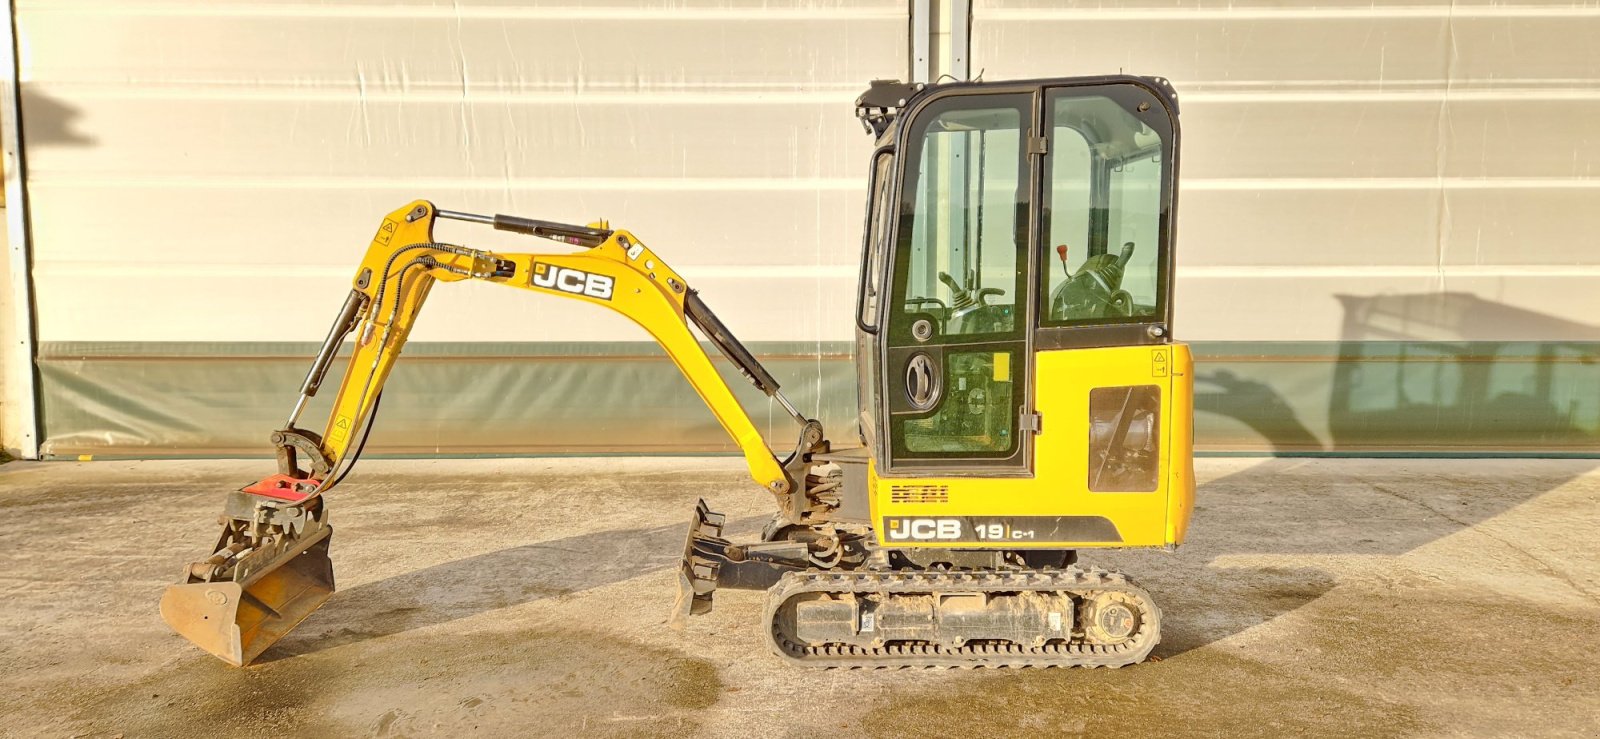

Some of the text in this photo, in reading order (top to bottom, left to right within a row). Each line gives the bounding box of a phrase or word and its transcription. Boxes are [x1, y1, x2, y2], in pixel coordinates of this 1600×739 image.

[533, 265, 614, 299] JCB
[889, 519, 962, 540] JCB
[974, 524, 1004, 539] 19
